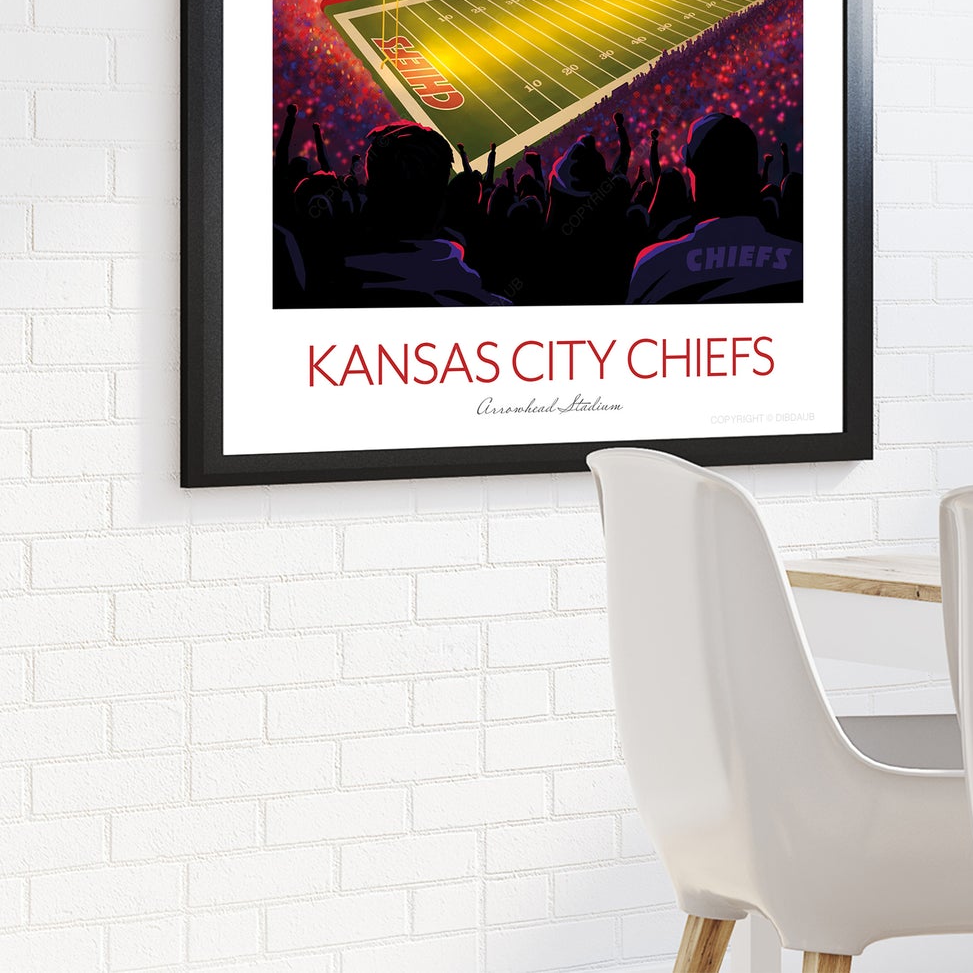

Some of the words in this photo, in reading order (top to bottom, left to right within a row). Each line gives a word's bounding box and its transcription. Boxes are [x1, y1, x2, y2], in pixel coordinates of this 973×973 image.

[438, 14, 454, 23] 10
[470, 5, 487, 14] 20
[370, 35, 465, 111] CHIEFS
[524, 79, 543, 93] 10
[561, 64, 580, 76] 20
[599, 49, 615, 60] 30
[632, 36, 647, 45] 40
[686, 243, 793, 272] CHIEFS
[309, 341, 501, 387] KANSAS
[511, 340, 617, 382] CITY
[627, 336, 775, 379] CHIEFS
[476, 397, 559, 415] Arrowhead
[557, 393, 623, 415] Stadium
